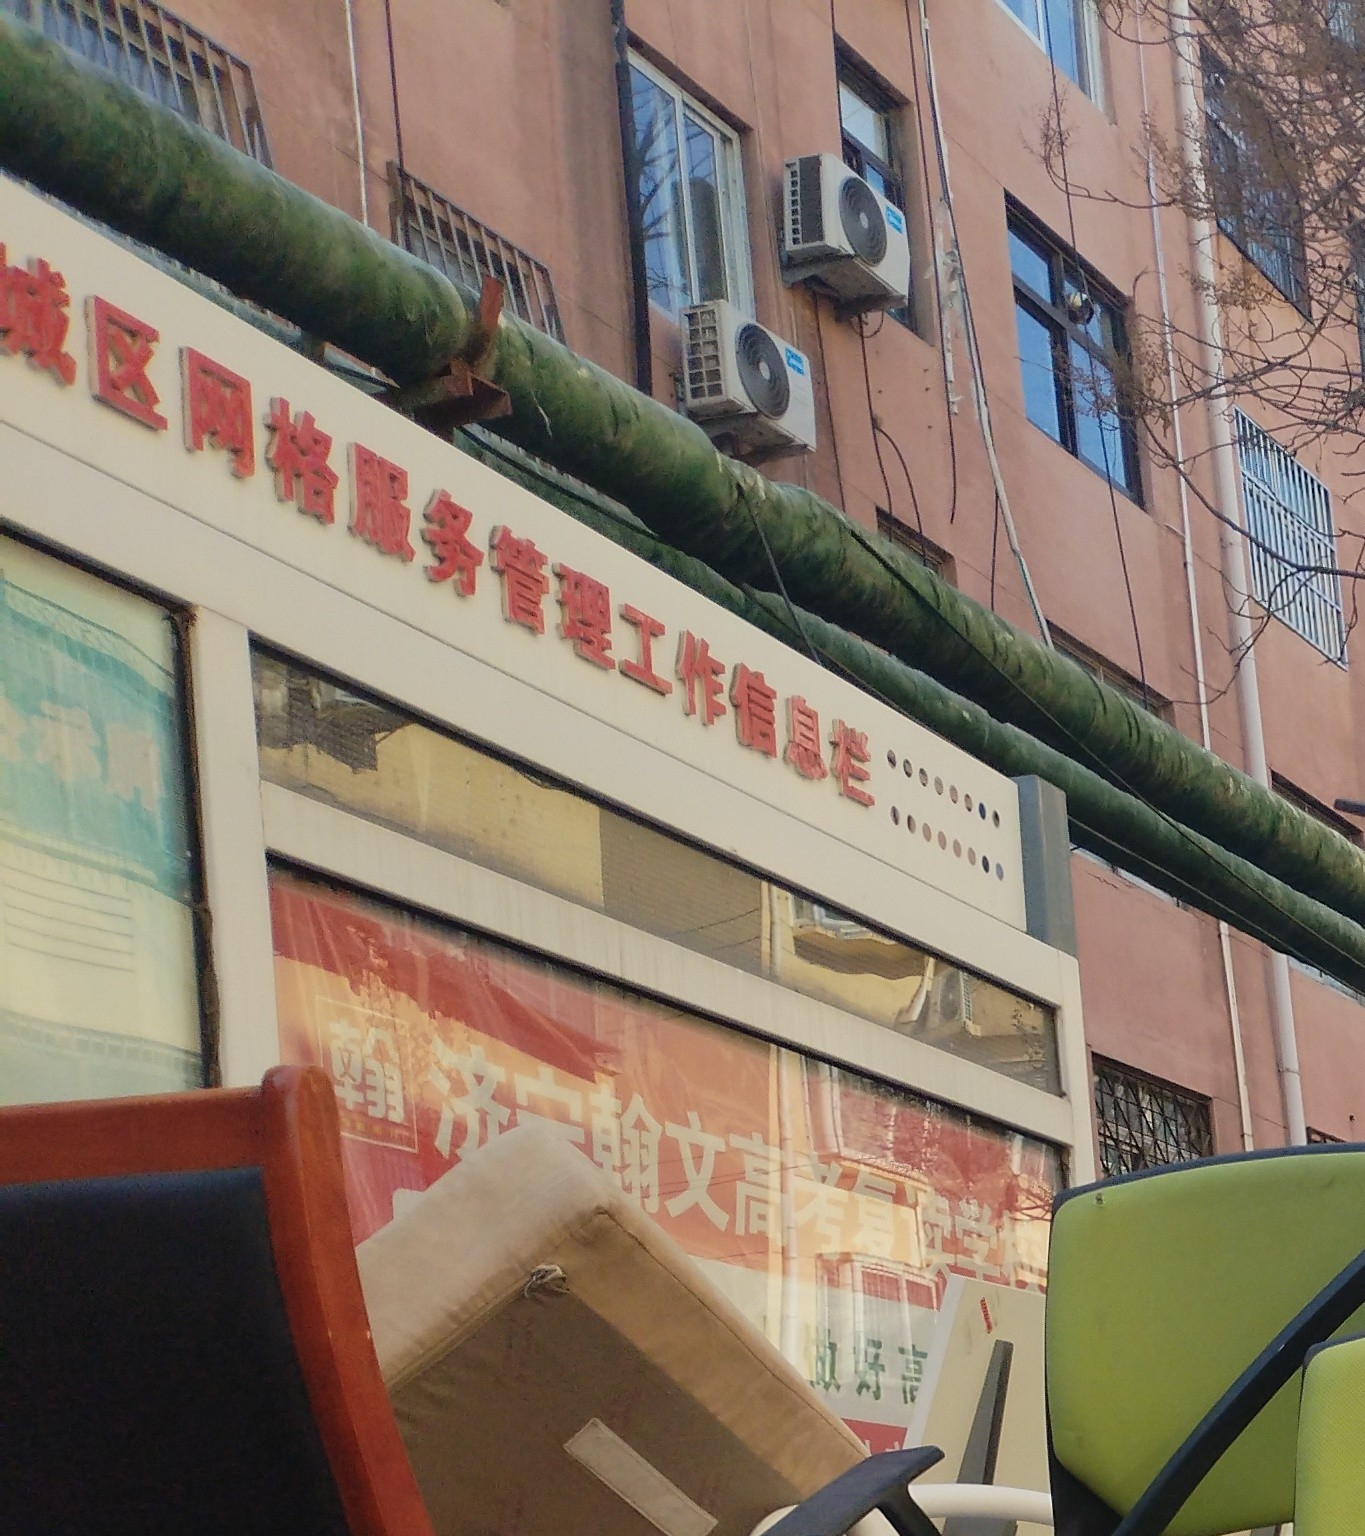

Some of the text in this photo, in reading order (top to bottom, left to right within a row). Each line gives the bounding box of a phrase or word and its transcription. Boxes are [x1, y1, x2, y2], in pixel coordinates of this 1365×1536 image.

[0, 241, 876, 808] 城区网格服务管理工作信息栏
